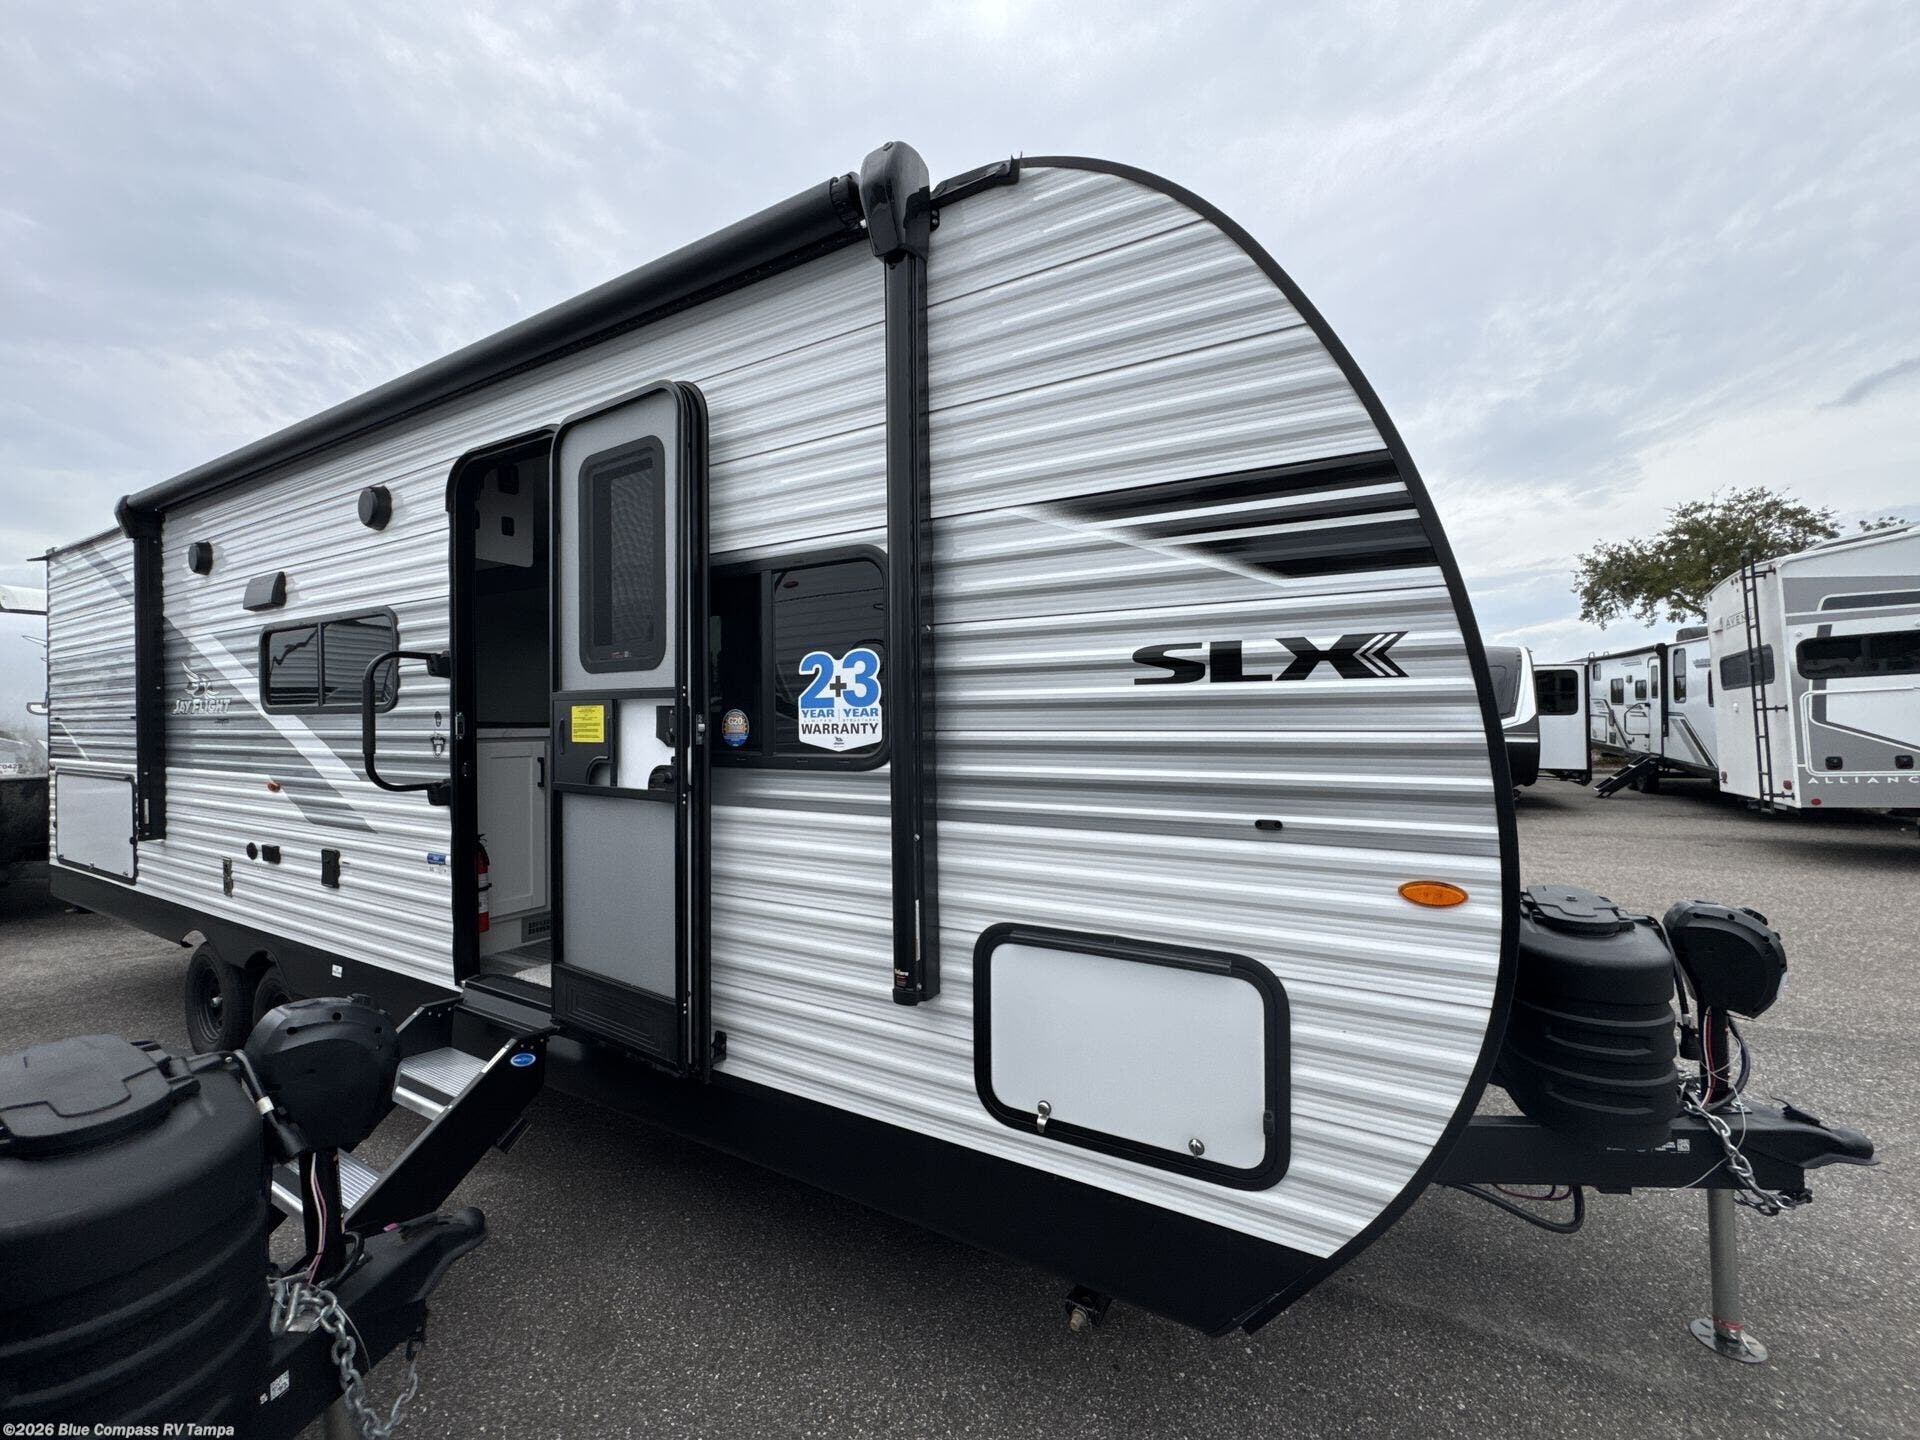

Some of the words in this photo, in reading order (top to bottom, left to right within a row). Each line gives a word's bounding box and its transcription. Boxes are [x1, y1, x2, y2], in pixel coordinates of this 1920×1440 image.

[1132, 631, 1409, 685] SLX
[172, 699, 191, 715] JAY
[190, 698, 231, 715] FLIGHT
[801, 709, 835, 718] YEAR
[842, 707, 879, 717] YEAR
[801, 723, 879, 735] WARRANTY
